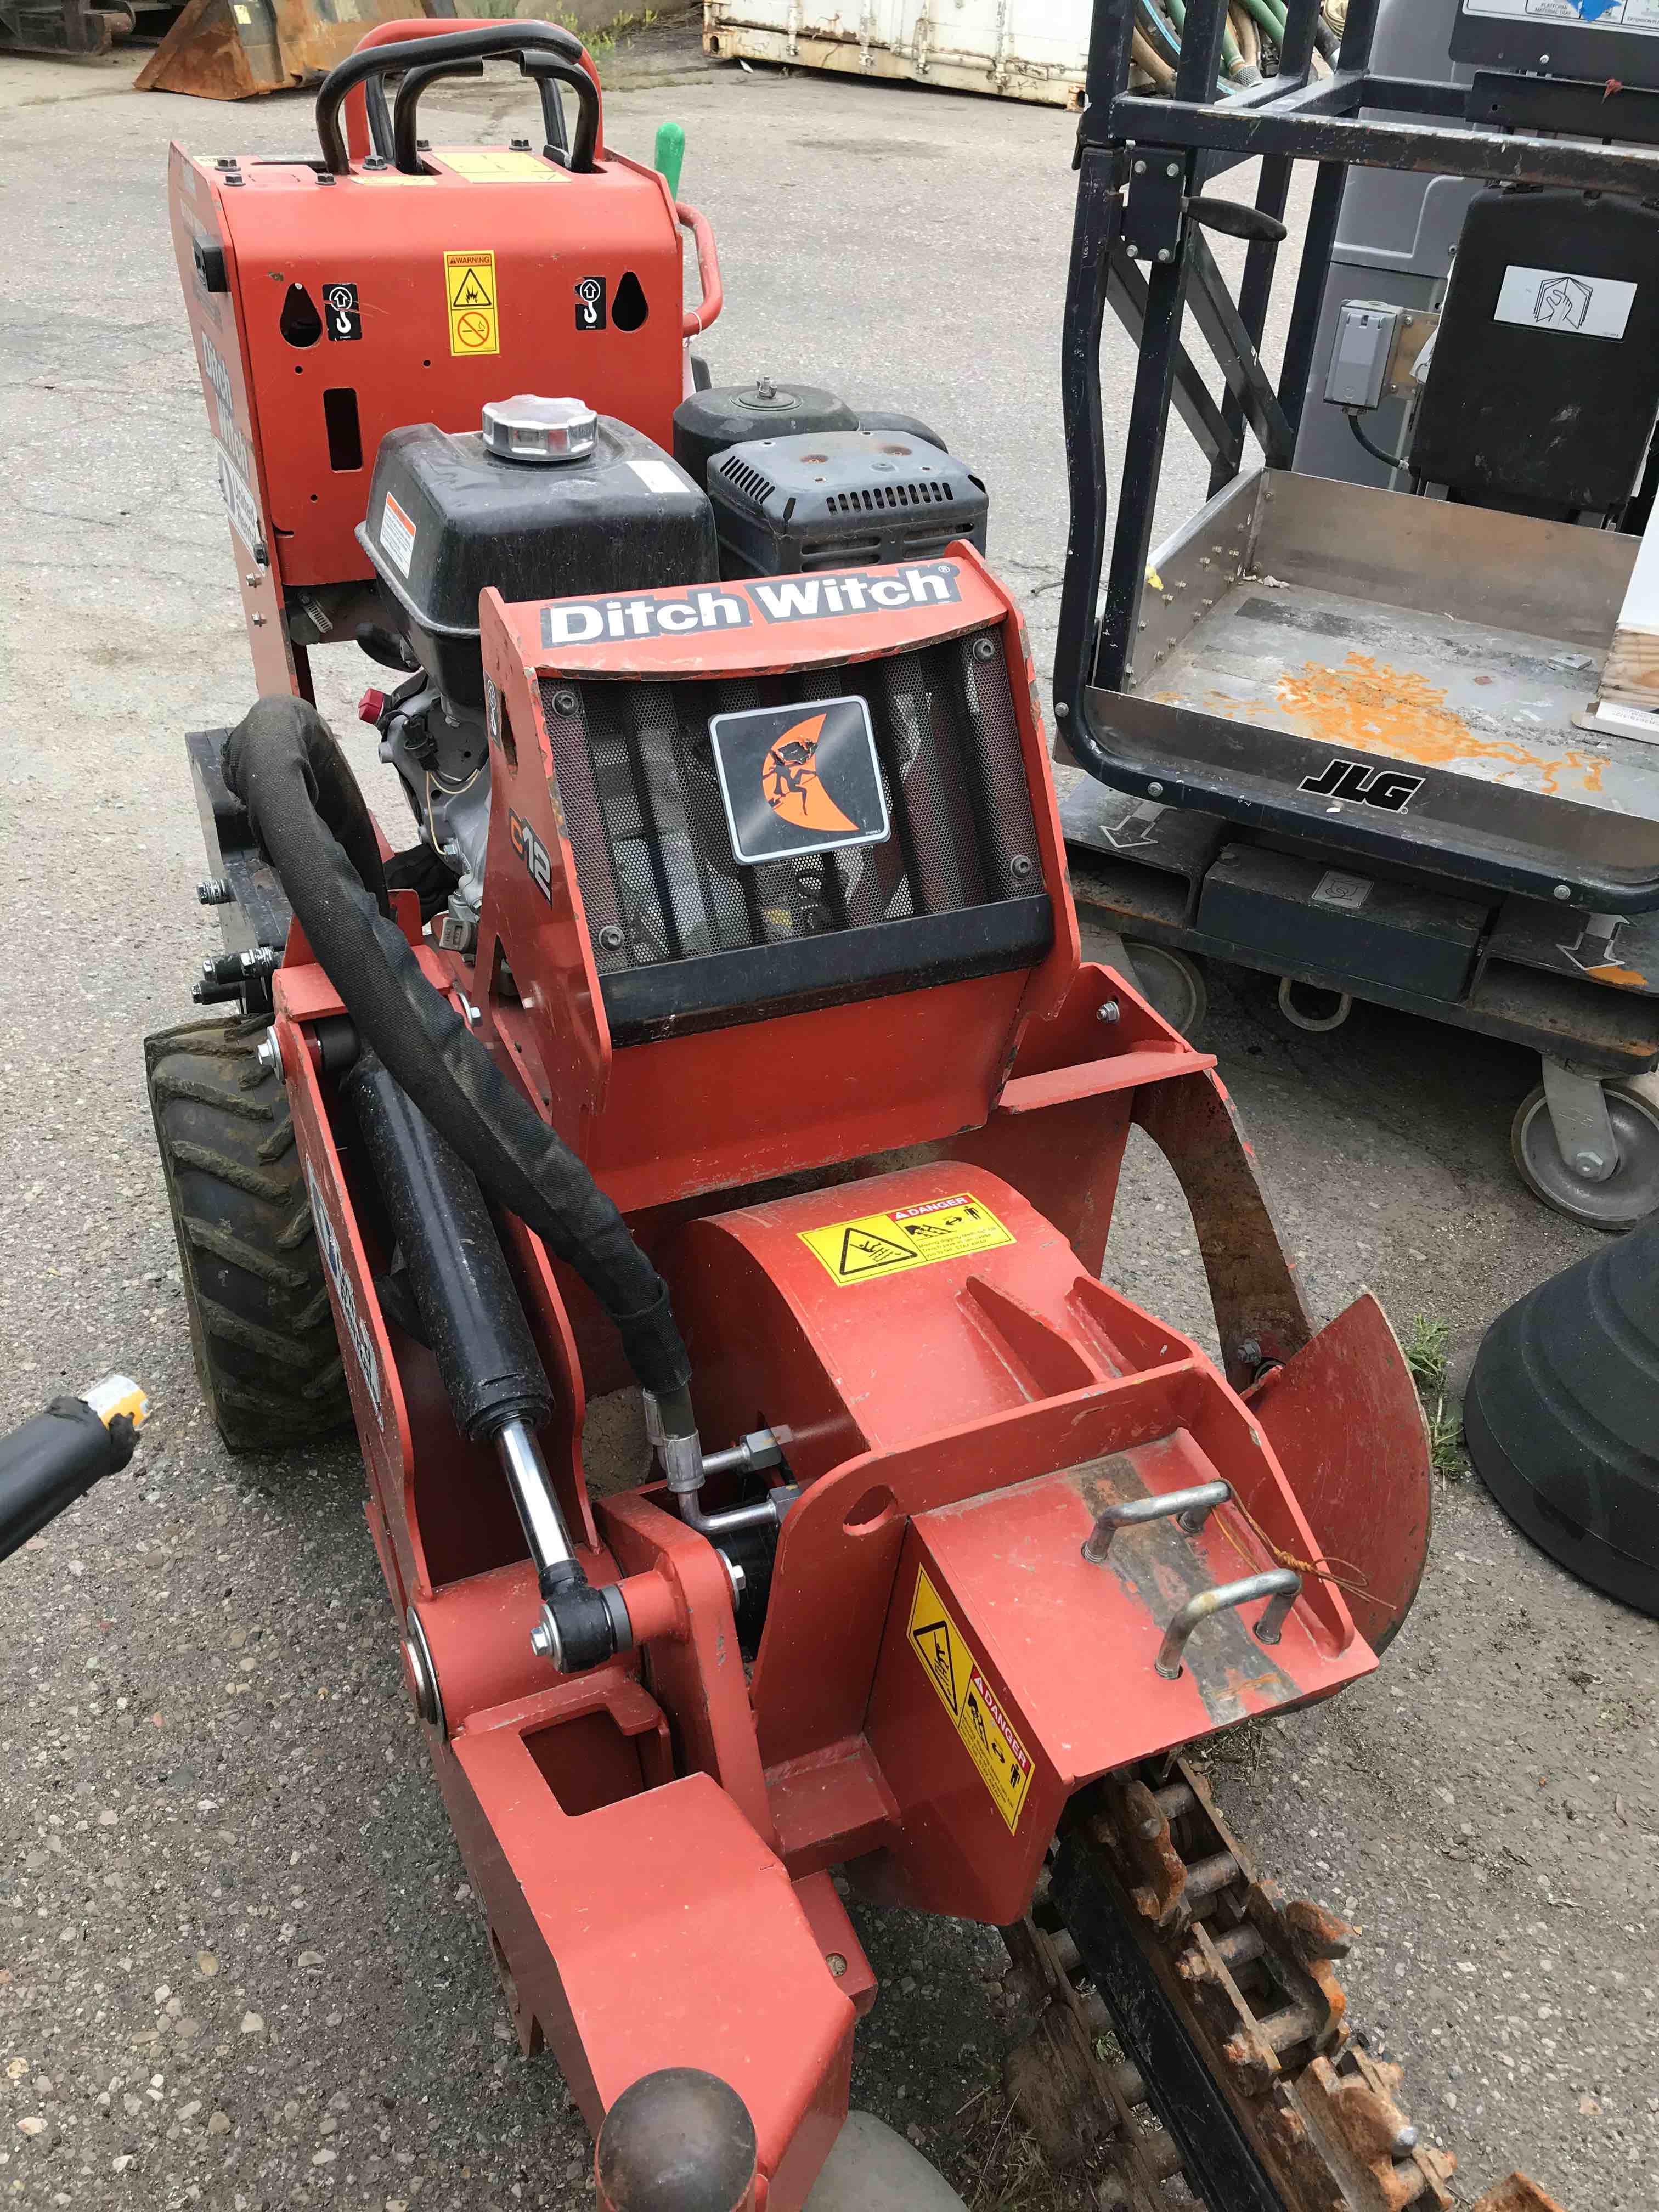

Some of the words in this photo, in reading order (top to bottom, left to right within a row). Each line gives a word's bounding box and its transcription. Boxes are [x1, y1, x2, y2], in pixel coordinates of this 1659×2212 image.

[456, 256, 490, 264] WARNING
[201, 330, 233, 413] Ditch
[216, 392, 250, 479] Witch
[550, 591, 742, 644] Ditch
[755, 569, 950, 619] Witch
[1296, 758, 1426, 813] JLG
[511, 814, 552, 904] C12
[907, 1197, 969, 1216] DANGER
[984, 1691, 1027, 1769] DANGER
